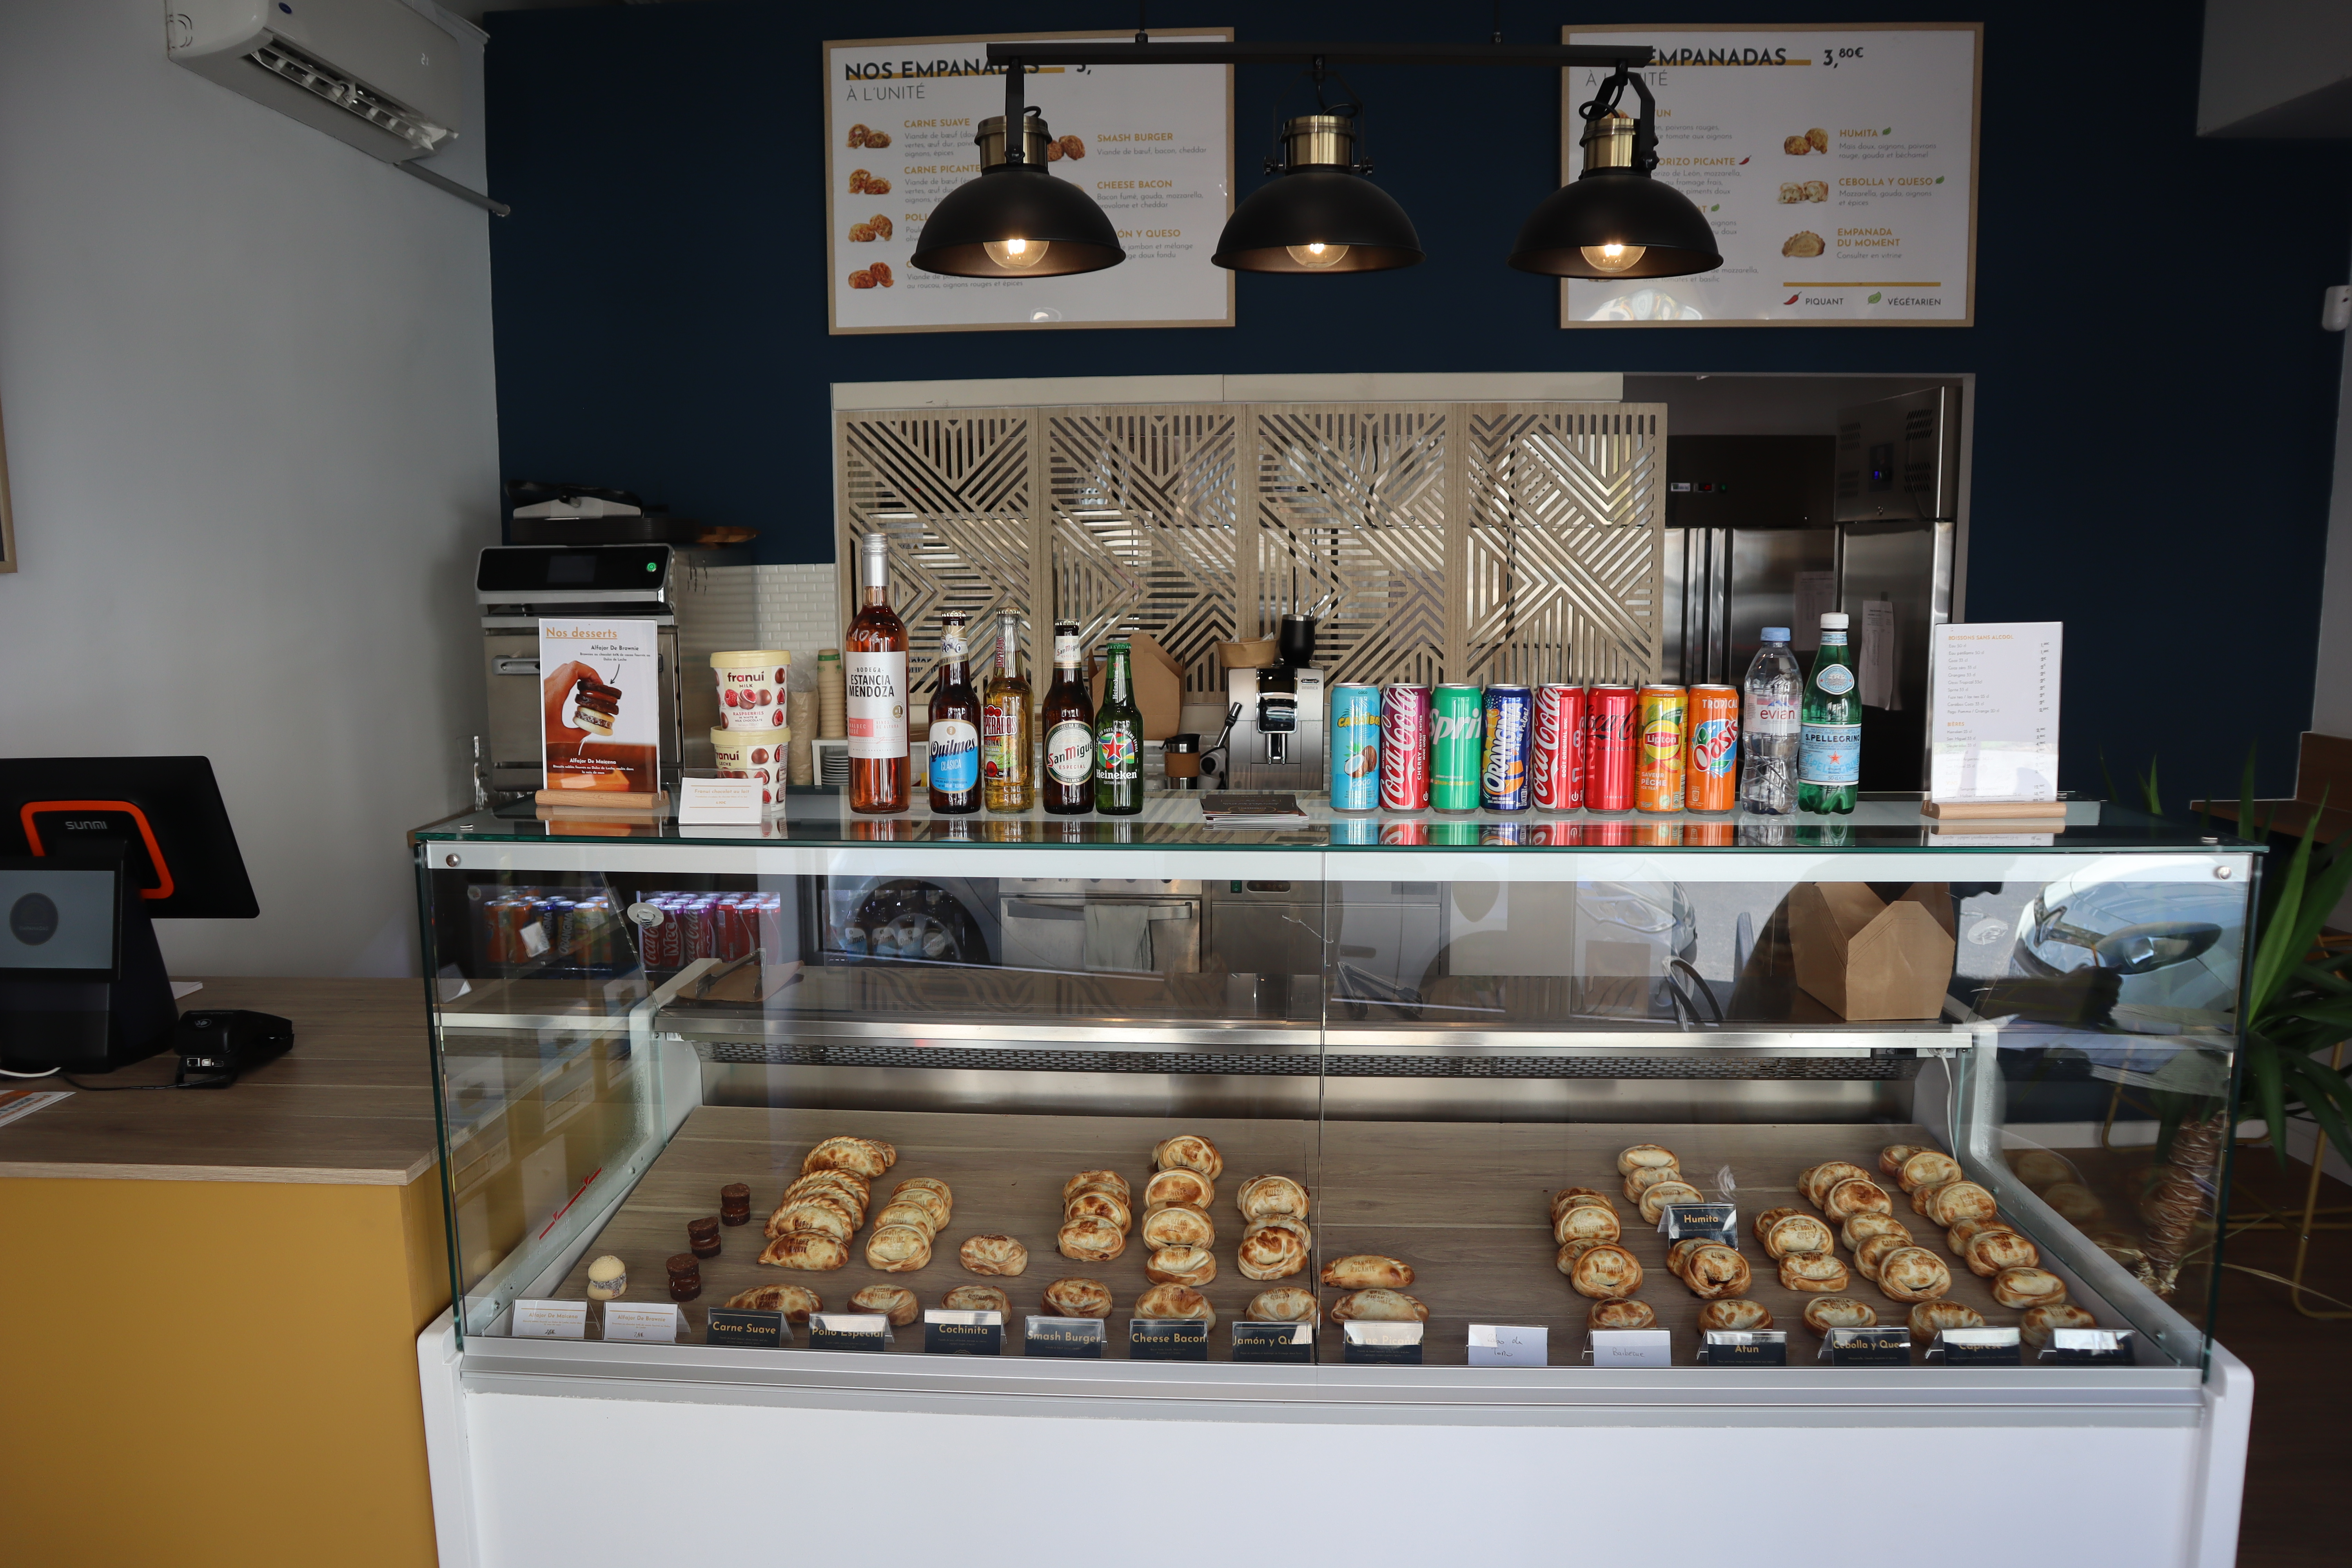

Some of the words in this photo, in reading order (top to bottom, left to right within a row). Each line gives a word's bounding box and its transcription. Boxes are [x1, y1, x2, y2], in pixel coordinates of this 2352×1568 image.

[846, 62, 893, 80] NOS
[846, 85, 857, 101] À
[864, 83, 926, 100] L'UNITÉ
[904, 119, 936, 128] CARNE
[940, 118, 970, 127] SUAVE
[904, 166, 936, 174] CARNE
[941, 164, 980, 172] PICANTE
[1898, 178, 1933, 186] QUESO
[1141, 192, 1164, 200] gouda,
[1145, 229, 1181, 237] QUESO
[1888, 297, 1941, 305] VÉGÉTARIEN
[546, 627, 568, 637] Nos
[572, 627, 617, 638] desserts
[996, 637, 1005, 668] DESPERADOS
[851, 675, 890, 685] ESTANCIA
[849, 686, 895, 697] MENDOZA
[1702, 699, 1737, 708] TROPICAL
[1760, 709, 1795, 720] evian
[1647, 735, 1677, 744] Lipton
[931, 738, 975, 762] Quilmes
[1484, 703, 1523, 792] ORANGINA
[1693, 719, 1739, 772] Oasis
[1096, 769, 1137, 779] Heineken
[664, 922, 678, 956] Mec
[1684, 1214, 1718, 1223] Humita
[713, 1321, 743, 1333] Carne
[746, 1323, 776, 1334] Suave
[812, 1326, 837, 1336] Pollo
[938, 1325, 988, 1335] Cochinita
[1027, 1331, 1061, 1341] Smash
[1065, 1332, 1100, 1343] Burger
[1132, 1333, 1170, 1343] Cheese
[1174, 1334, 1206, 1343] Bacon
[1233, 1335, 1265, 1345] Jamón
[1269, 1338, 1274, 1347] y
[1833, 1340, 1868, 1349] Cebolla
[1871, 1343, 1876, 1352] y
